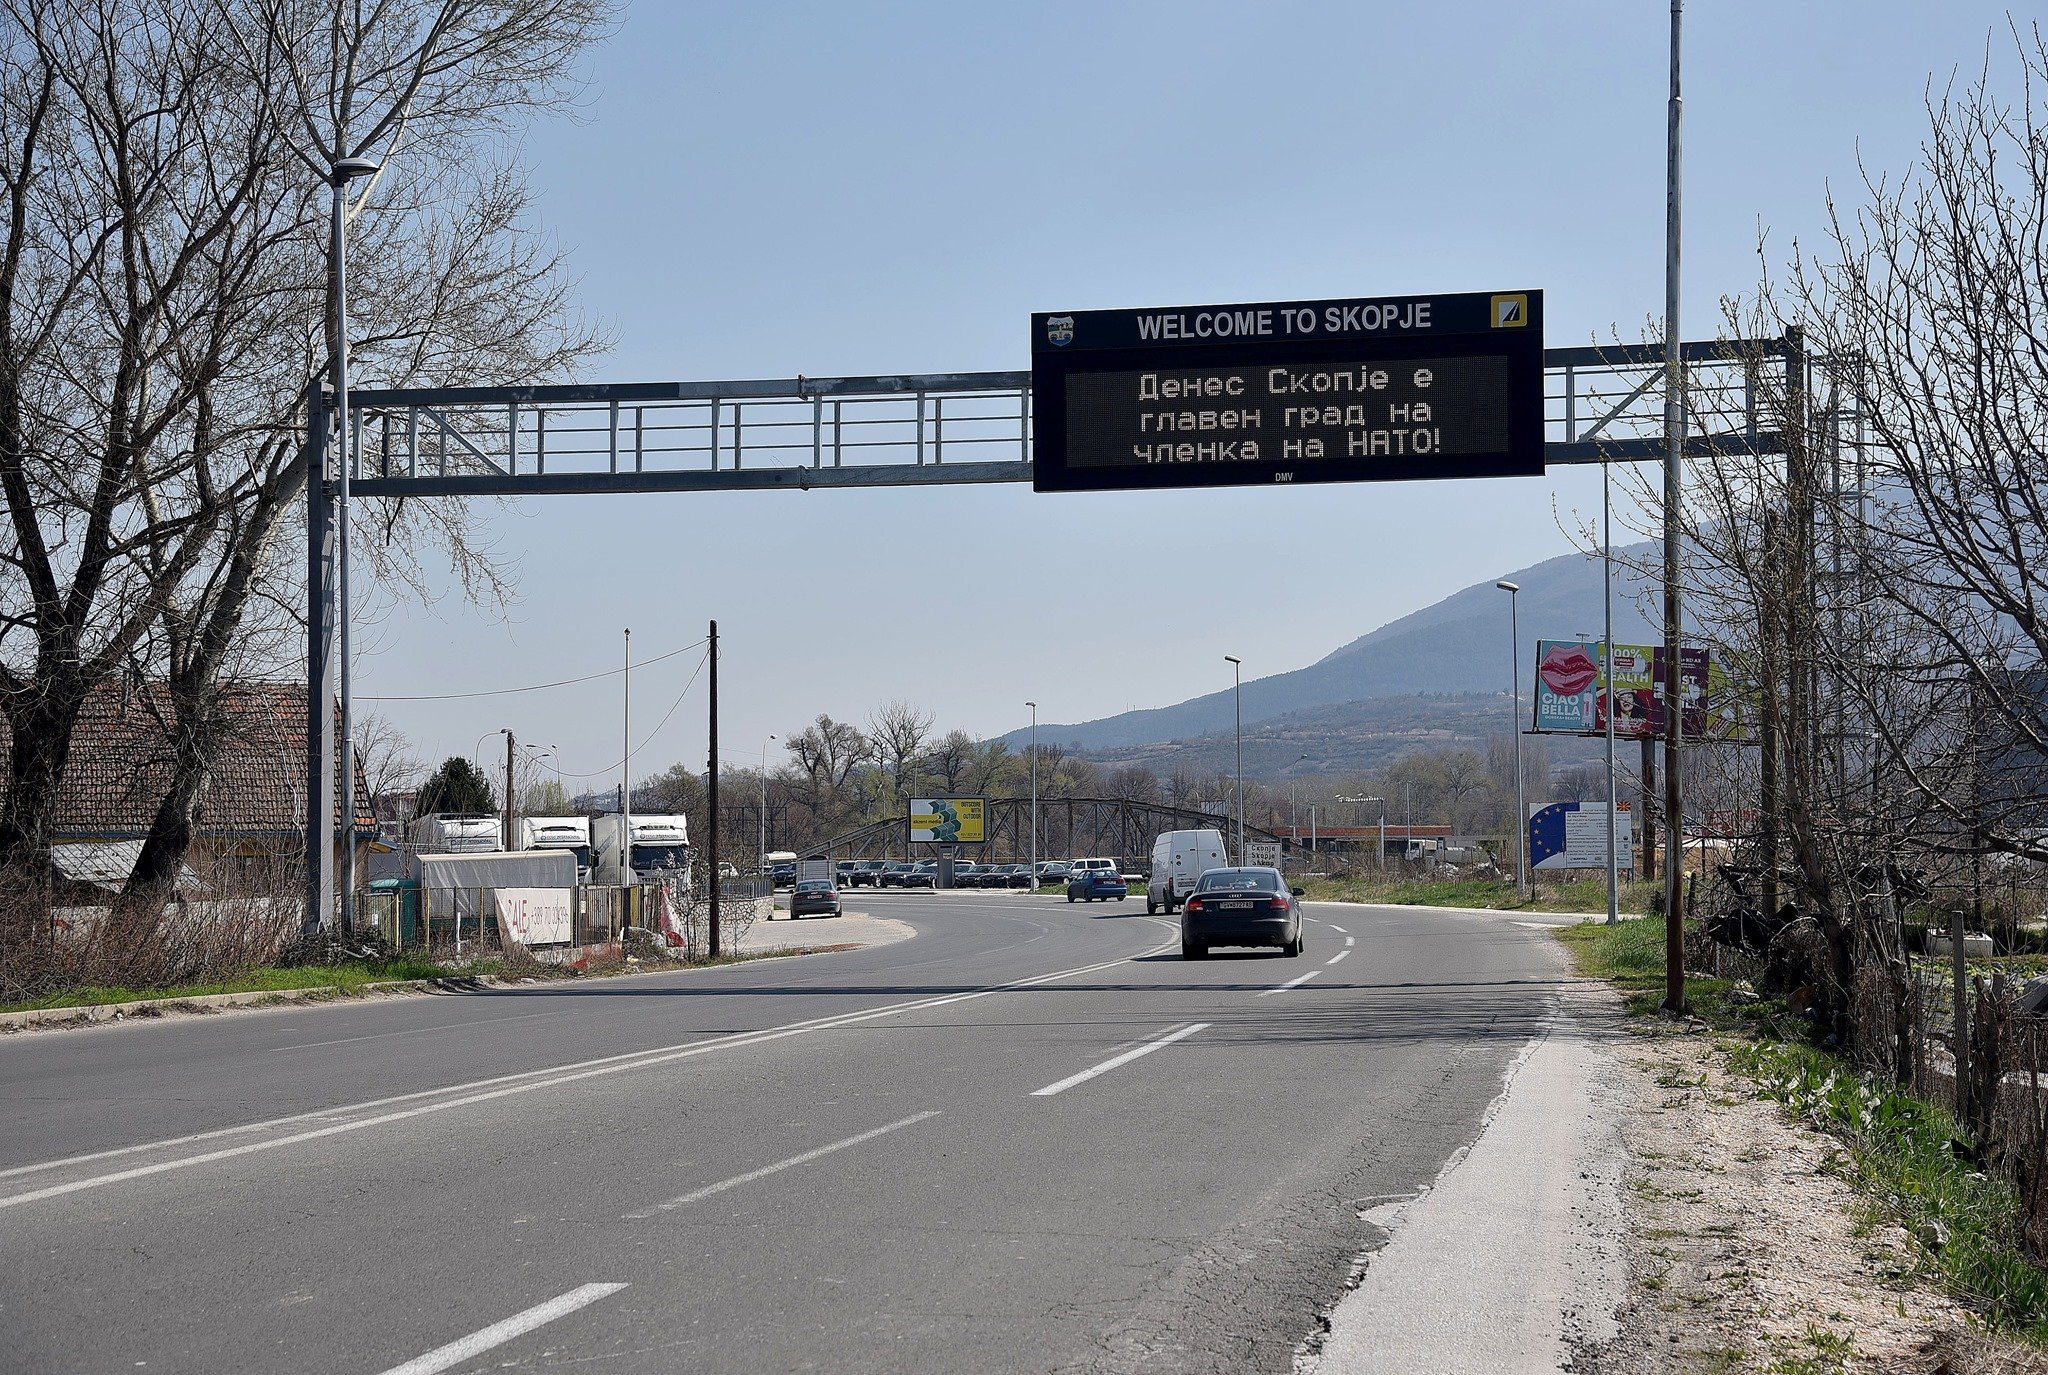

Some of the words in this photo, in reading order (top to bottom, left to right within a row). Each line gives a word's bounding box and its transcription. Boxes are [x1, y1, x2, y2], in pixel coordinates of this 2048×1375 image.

[1137, 309, 1273, 340] WELCOME
[1280, 308, 1316, 334] TO
[1324, 302, 1432, 332] SKOPJE
[1138, 373, 1245, 401] Денес
[1268, 365, 1389, 394] Скопје
[1413, 368, 1433, 388] е
[1141, 409, 1261, 432] главен
[1284, 404, 1365, 428] град
[1389, 402, 1432, 423] на
[1133, 440, 1259, 463] членка
[1283, 438, 1324, 459] на
[1348, 427, 1440, 456] НАТО!
[1275, 472, 1293, 482] DMV
[1614, 648, 1641, 658] 00%
[1542, 692, 1580, 706] CIAO
[1541, 704, 1581, 717] BELLA
[1251, 844, 1276, 852] Скопје
[1251, 852, 1276, 860] Skopje
[507, 899, 528, 934] ALE
